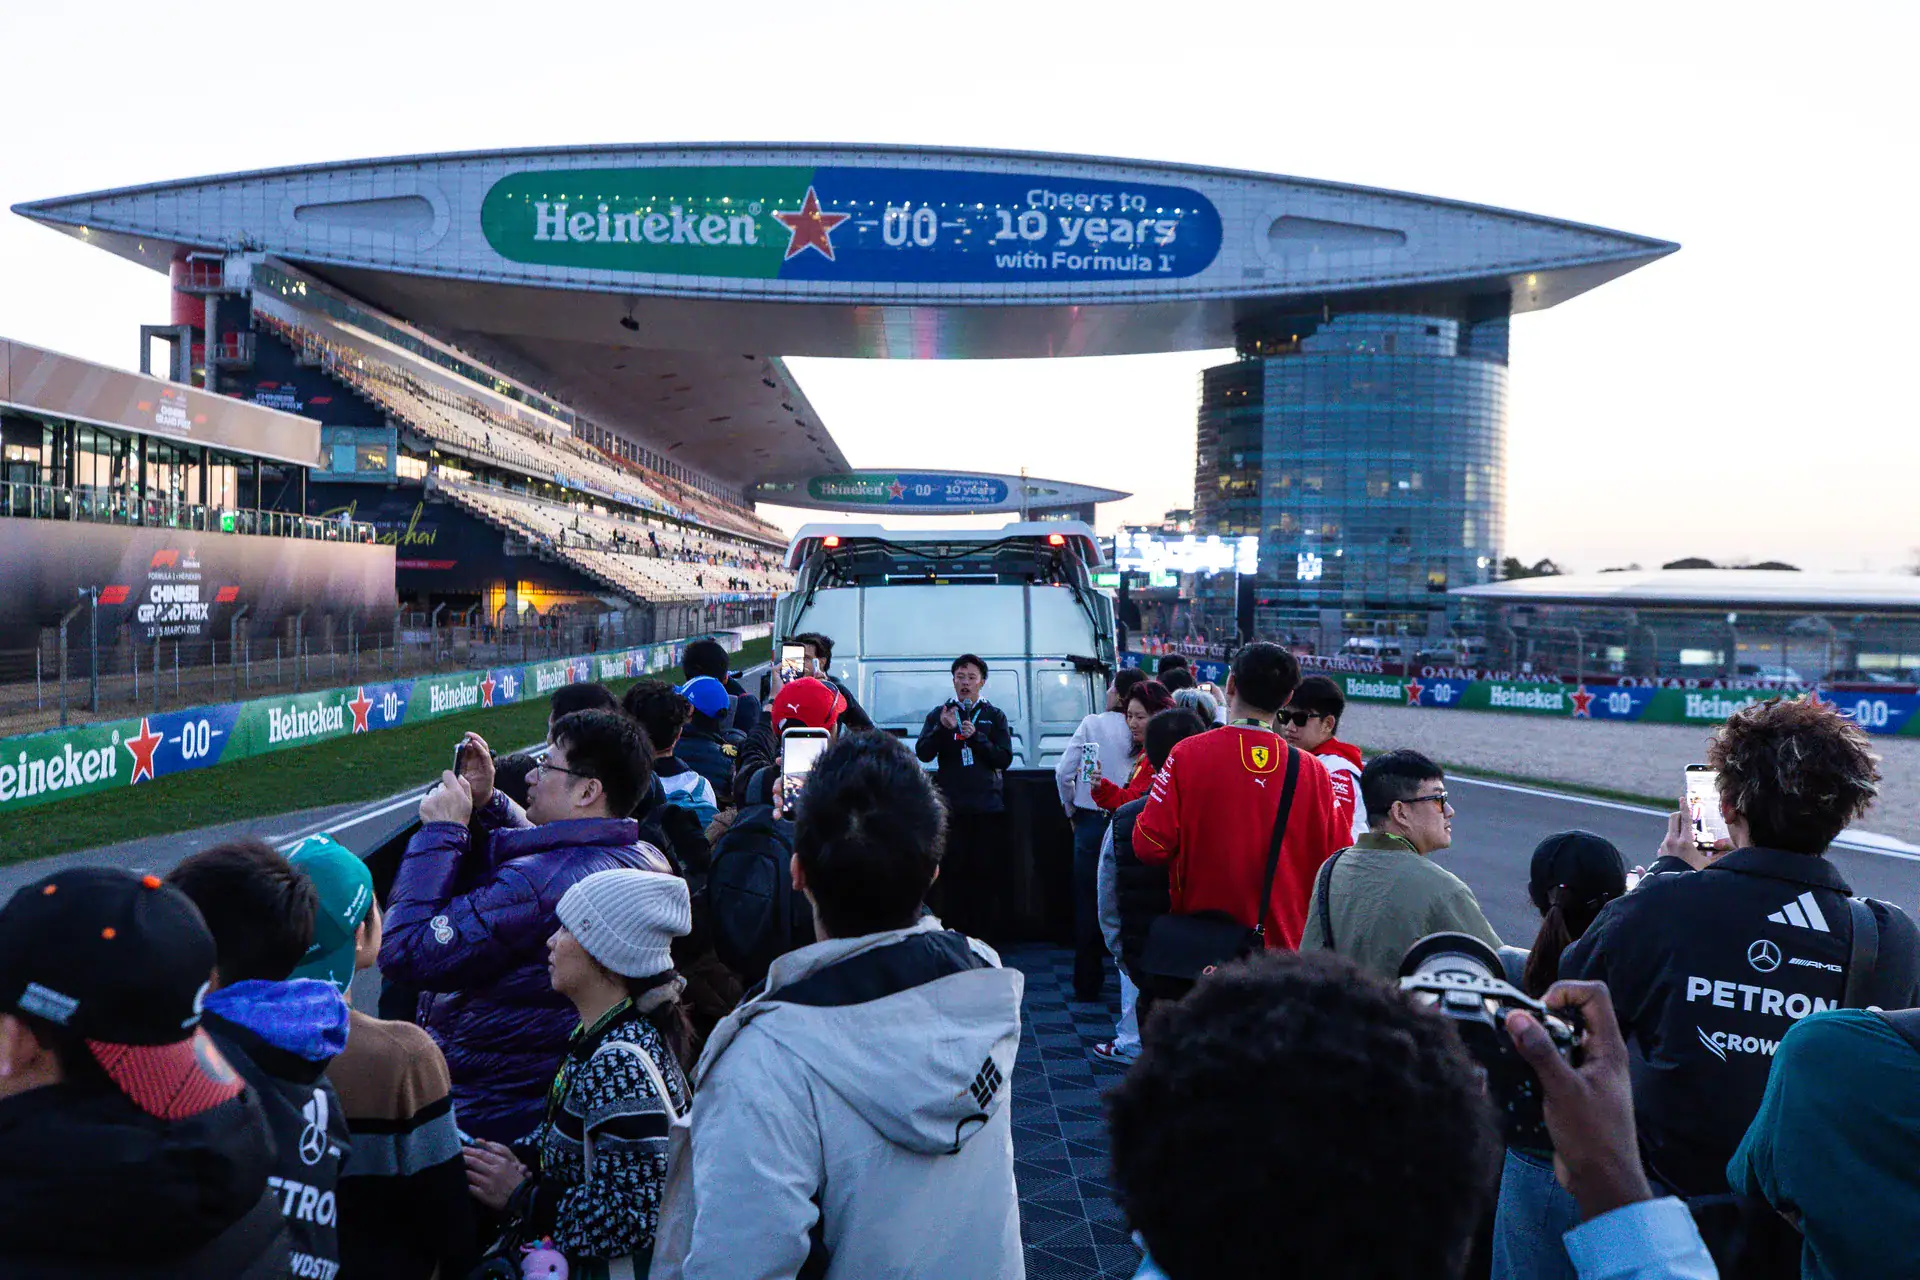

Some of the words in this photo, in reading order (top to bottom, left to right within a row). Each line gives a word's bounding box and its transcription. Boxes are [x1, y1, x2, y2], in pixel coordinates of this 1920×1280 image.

[1026, 189, 1114, 209] Cheers
[1118, 191, 1147, 211] to
[994, 209, 1048, 241] 10
[1057, 216, 1178, 247] years
[994, 251, 1048, 269] with
[1051, 251, 1153, 272] Formula
[821, 483, 883, 497] Heineken
[945, 485, 961, 495] 10
[150, 584, 200, 603] CHINESE
[182, 602, 209, 621] PRIX
[1421, 664, 1478, 681] QATAR
[0, 742, 118, 802] eineken
[1806, 960, 1843, 973] AMG
[1685, 975, 1839, 1020] PETRON
[1710, 1031, 1781, 1057] CROW
